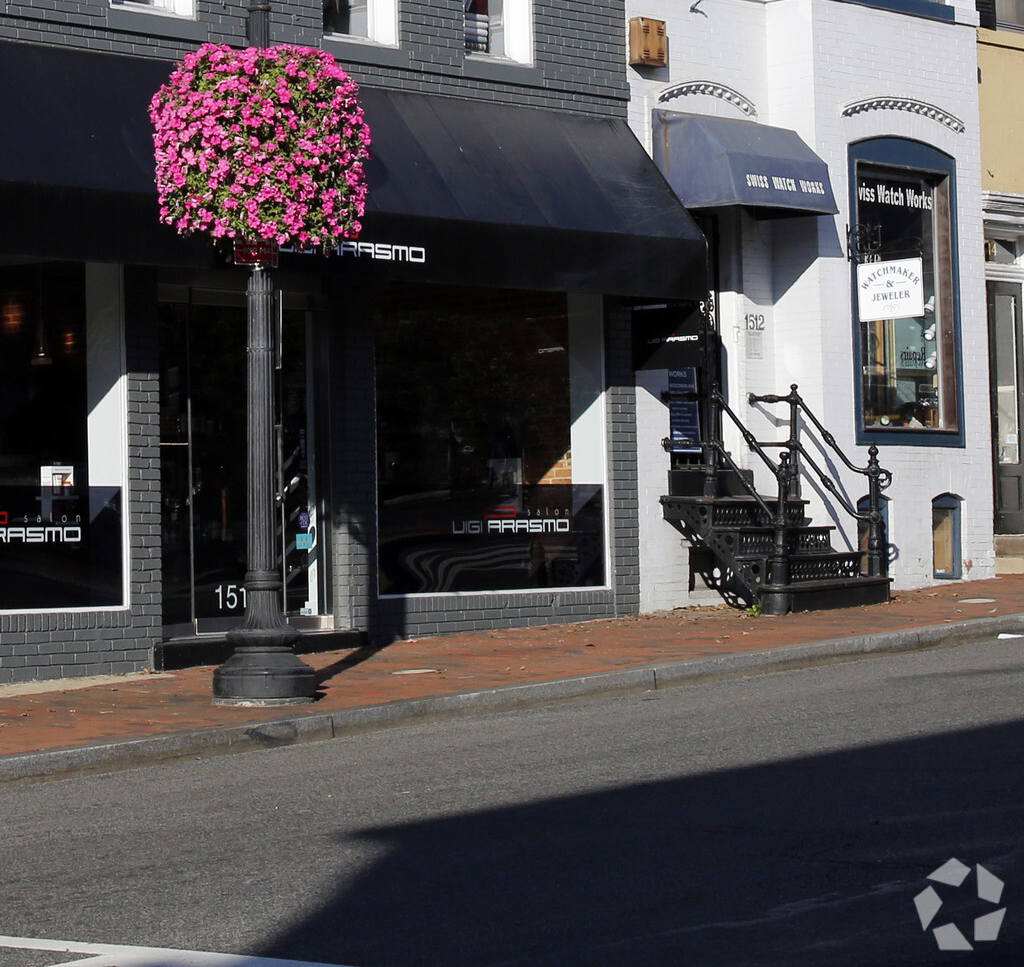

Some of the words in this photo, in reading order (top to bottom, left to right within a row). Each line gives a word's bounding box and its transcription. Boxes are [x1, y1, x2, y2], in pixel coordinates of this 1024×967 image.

[746, 173, 769, 189] SWISS
[772, 176, 797, 191] WATCH
[799, 179, 825, 194] WORKS
[877, 184, 904, 206] Watch
[906, 188, 933, 210] Works
[861, 266, 920, 290] WATCHMAKER
[886, 280, 894, 288] &
[871, 290, 910, 302] JEWELER
[745, 313, 765, 330] 1512
[23, 512, 81, 523] salon
[527, 506, 570, 517] salon
[215, 584, 247, 610] 151
